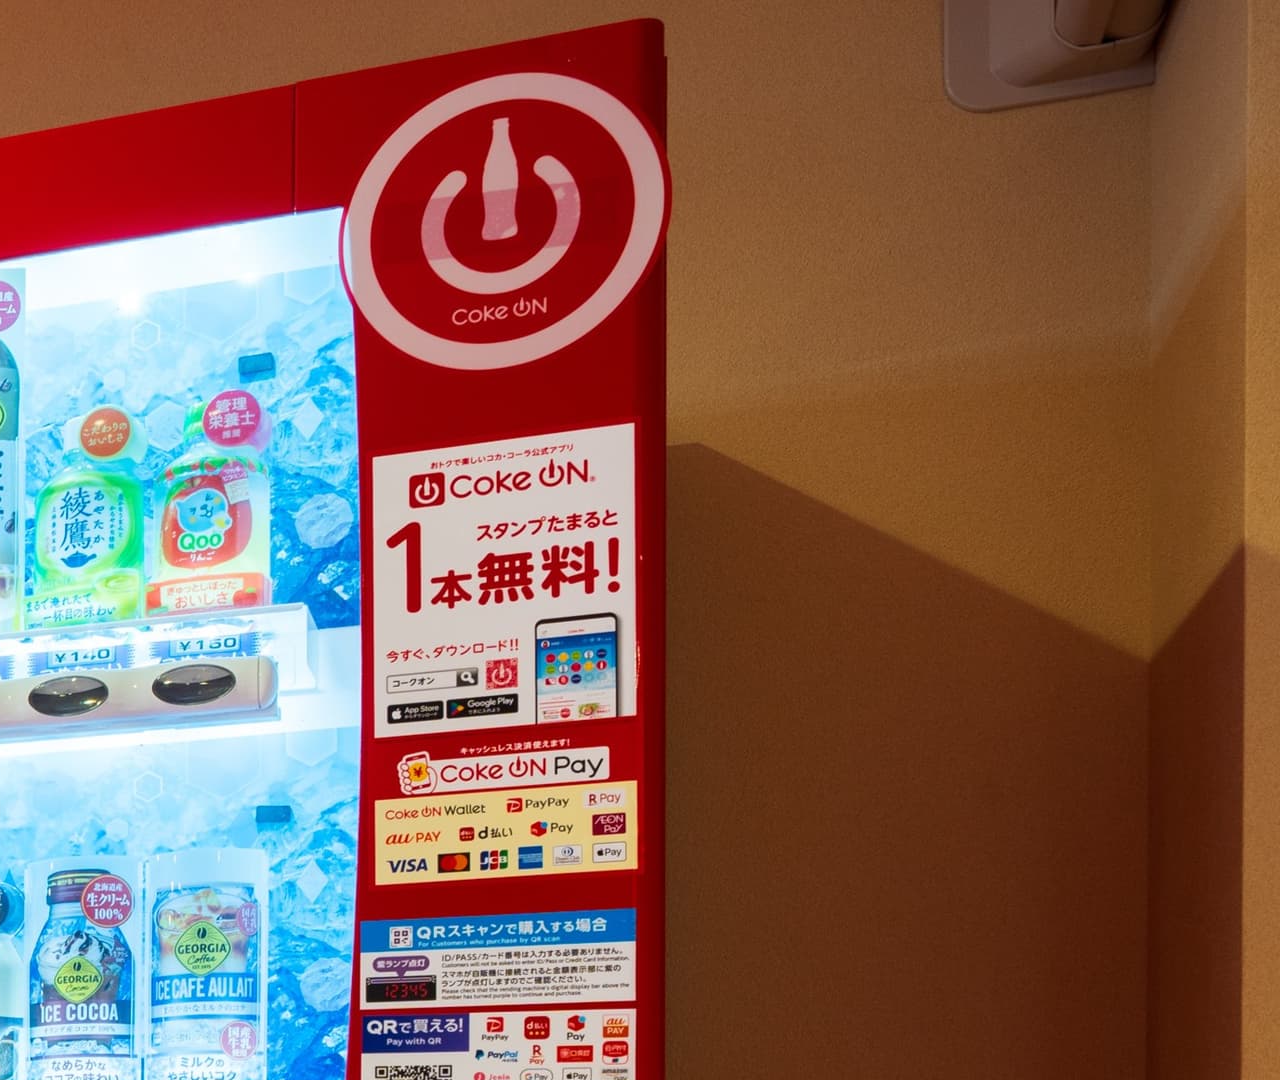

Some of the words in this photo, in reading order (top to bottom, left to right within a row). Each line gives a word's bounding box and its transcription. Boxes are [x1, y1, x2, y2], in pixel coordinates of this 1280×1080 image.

[452, 304, 508, 325] Coke
[208, 412, 255, 430] 栄養士
[450, 470, 531, 499] Coke
[540, 459, 589, 487] ON
[60, 488, 91, 551] 綾鷹
[93, 490, 105, 543] あやたか
[477, 510, 618, 541] スタンプたまると
[180, 532, 221, 550] Qoo
[386, 522, 620, 614] 1本無料!
[175, 592, 228, 608] おいしさ
[392, 676, 435, 688] コークオン
[420, 704, 439, 713] Store
[467, 699, 496, 708] Google
[497, 697, 514, 706] Play
[460, 739, 570, 754] キャッシュレス決済使えます!
[440, 764, 503, 782] Coke
[509, 756, 546, 776] ON
[554, 756, 603, 778] Pay
[385, 807, 419, 820] Coke
[444, 804, 486, 816] Wallet
[525, 797, 570, 811] PayPay
[600, 793, 621, 804] Pay
[385, 833, 416, 845] au
[416, 832, 441, 843] PAY
[550, 823, 573, 834] Pay
[387, 858, 428, 873] VISA
[604, 847, 622, 857] Pay
[86, 893, 130, 908] 生クリーム
[94, 908, 123, 920] 100%
[417, 917, 608, 939] QRスキャンで購入する場合
[177, 943, 227, 954] GEORGIA
[41, 1004, 61, 1023] ICE
[66, 1003, 119, 1021] COCOA
[366, 1018, 464, 1035] QRで買える!
[386, 1038, 402, 1047] Pay
[405, 1037, 424, 1045] with
[427, 1037, 441, 1045] QR
[567, 1032, 585, 1041] Pay
[180, 1056, 225, 1068] ミルクの
[487, 1051, 518, 1059] PayPal
[51, 1059, 106, 1071] なめらかな
